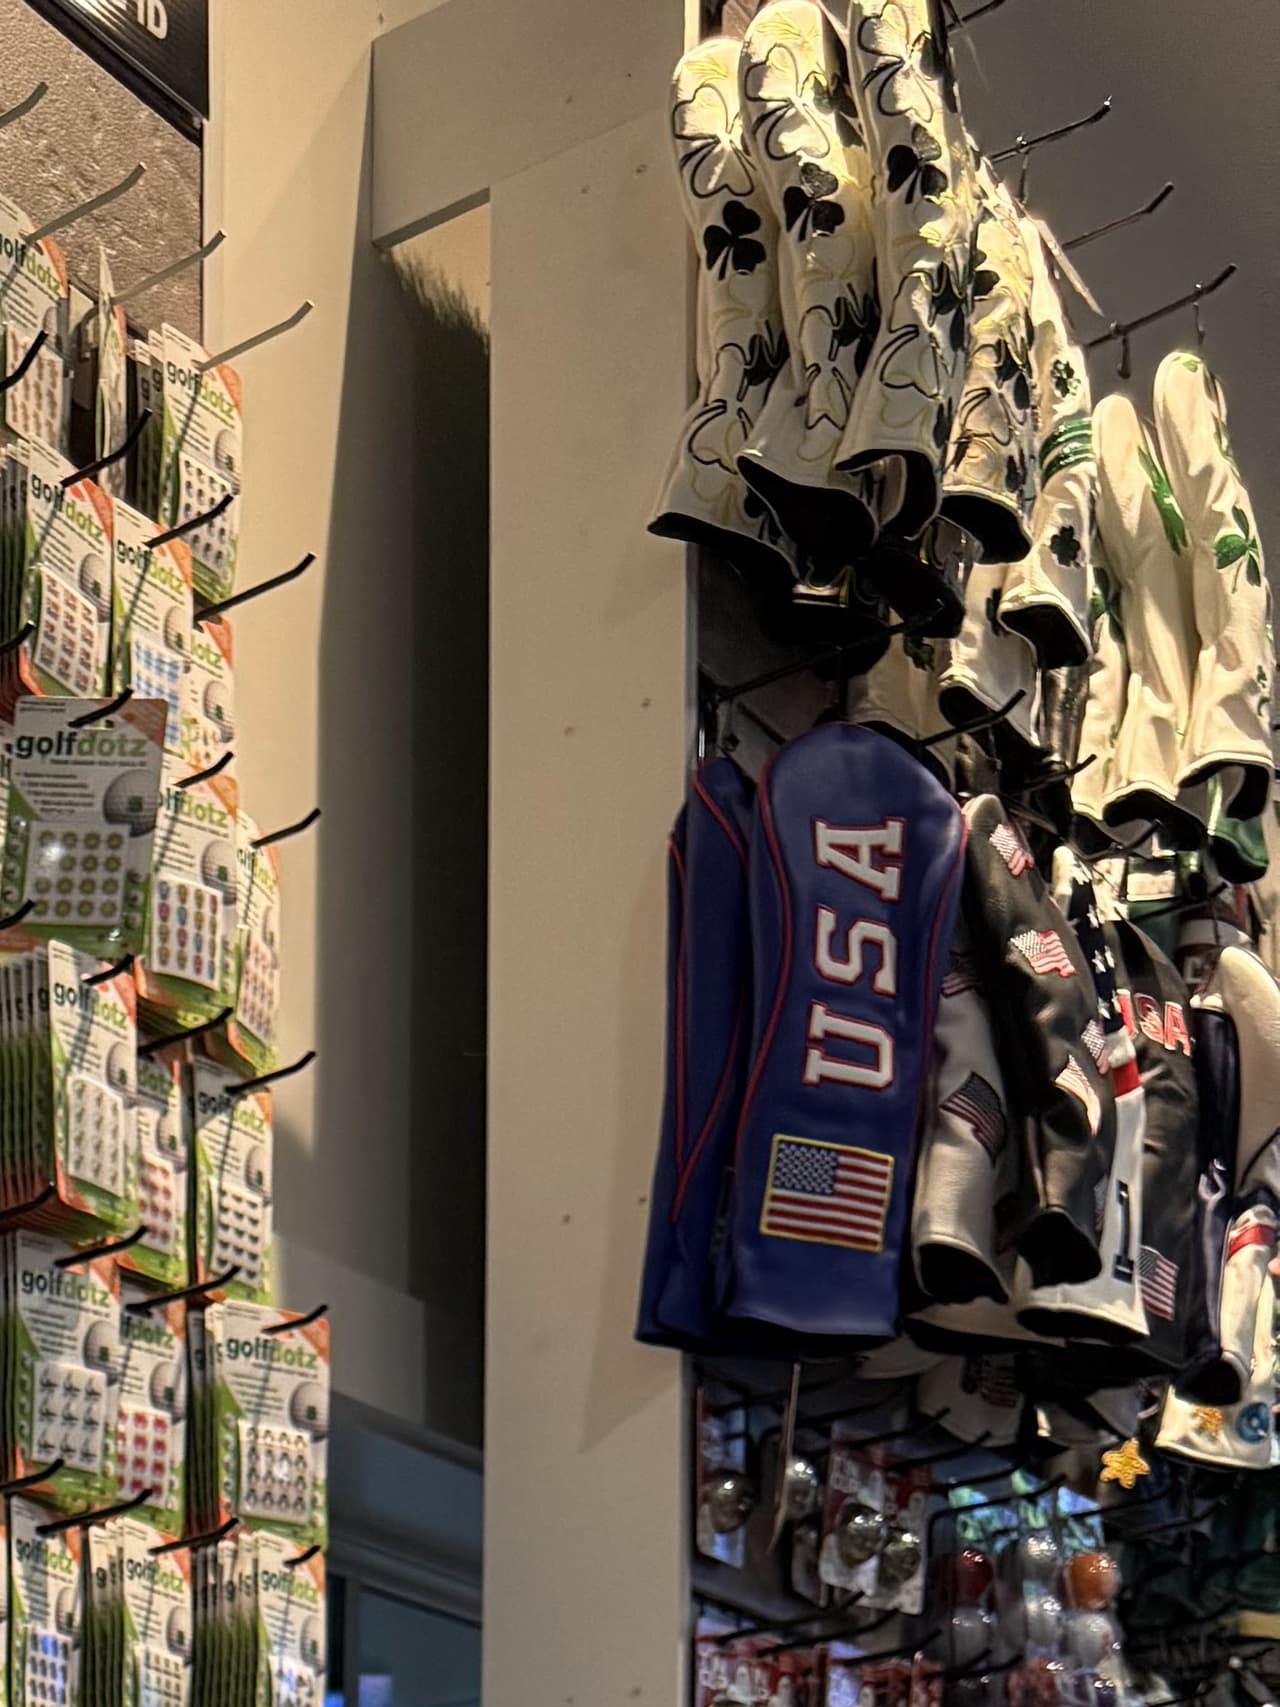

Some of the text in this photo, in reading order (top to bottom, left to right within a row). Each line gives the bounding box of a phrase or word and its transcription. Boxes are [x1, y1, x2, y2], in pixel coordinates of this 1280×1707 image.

[167, 357, 234, 414] golfdotz
[31, 474, 104, 541] golfdotz
[116, 537, 184, 591] golfdotz
[16, 730, 146, 758] golfdotz
[802, 816, 906, 1090] USA
[55, 981, 127, 1028] golfdotz
[199, 1090, 264, 1132] golfdotz
[22, 1269, 109, 1307] golfdotz
[226, 1334, 317, 1369] golfdotz
[15, 1537, 73, 1575] golfdotz
[126, 1557, 184, 1591] golfdotz
[261, 1569, 318, 1598] golfdotz
